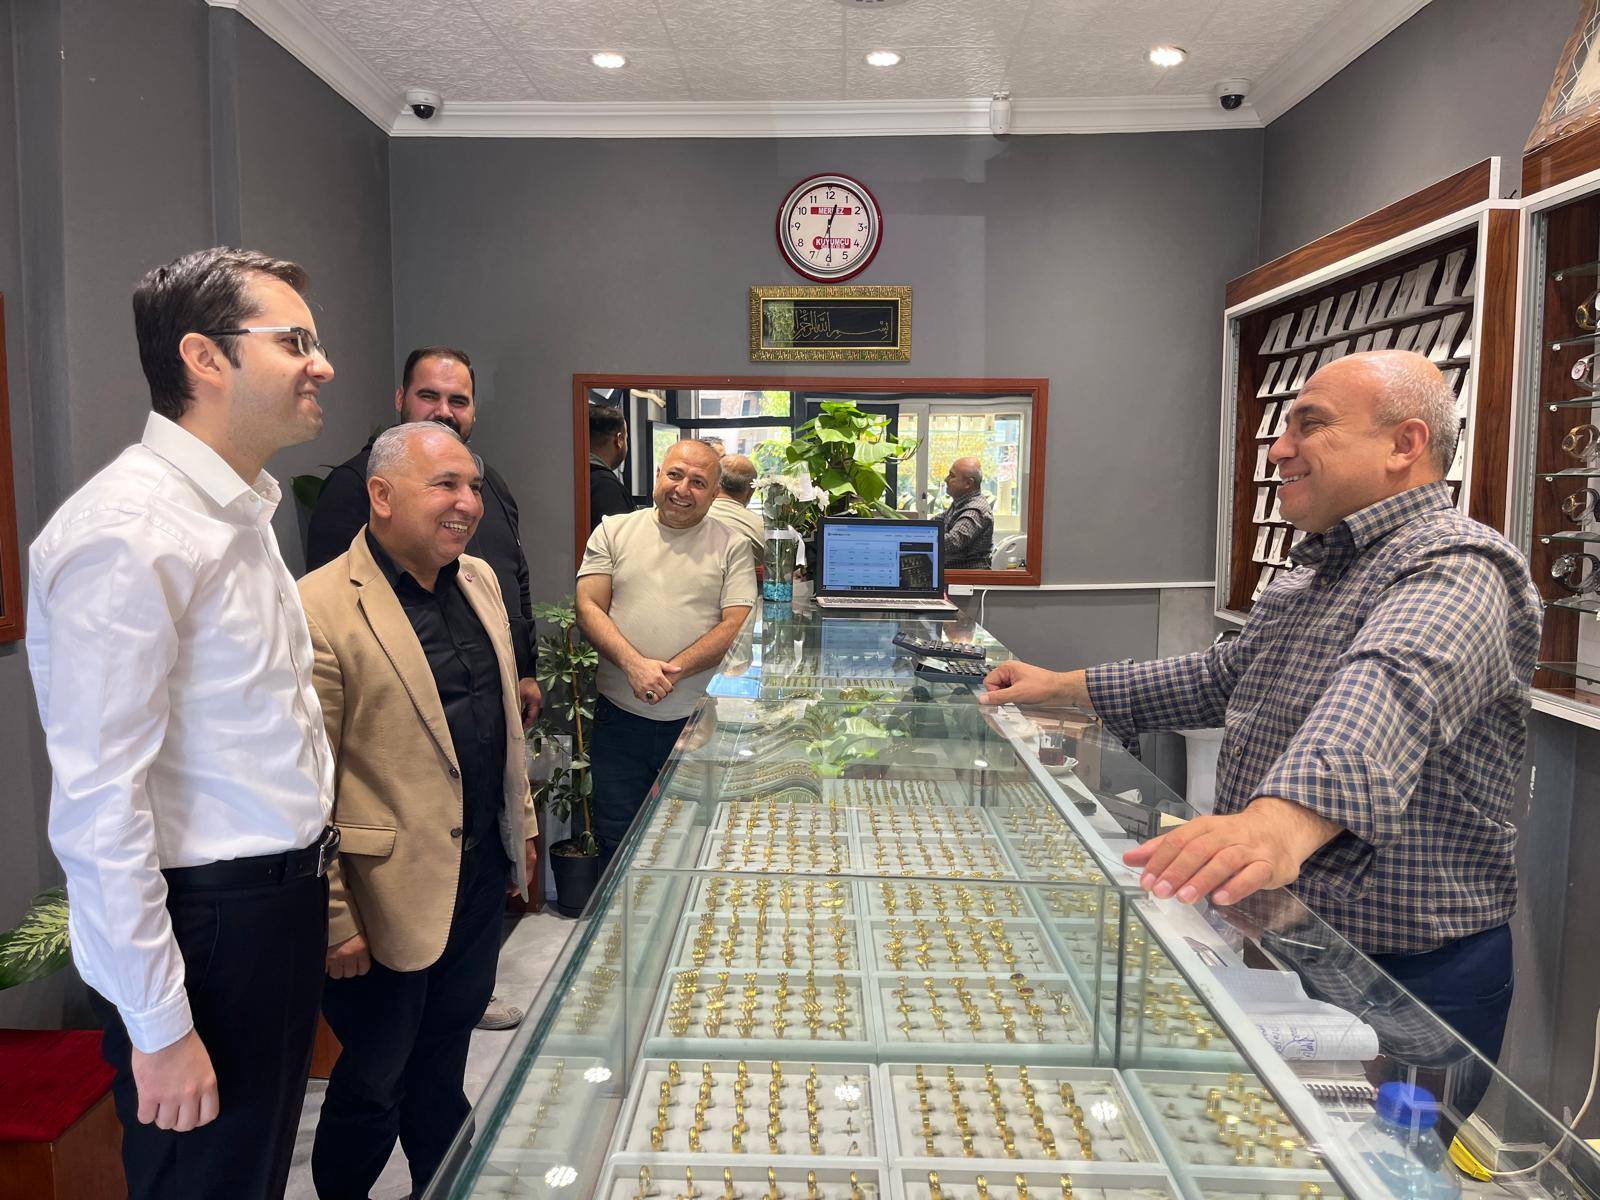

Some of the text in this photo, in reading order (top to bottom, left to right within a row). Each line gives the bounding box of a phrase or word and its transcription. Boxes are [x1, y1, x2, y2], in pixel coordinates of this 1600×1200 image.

[809, 196, 817, 204] 11
[825, 191, 835, 200] 12
[798, 207, 807, 215] 10
[854, 207, 861, 215] 2
[794, 222, 801, 231] 9
[857, 223, 864, 232] 3
[797, 238, 804, 247] 8
[853, 239, 860, 247] 4
[809, 250, 816, 259] 7
[825, 254, 831, 262] 6
[842, 251, 848, 260] 5
